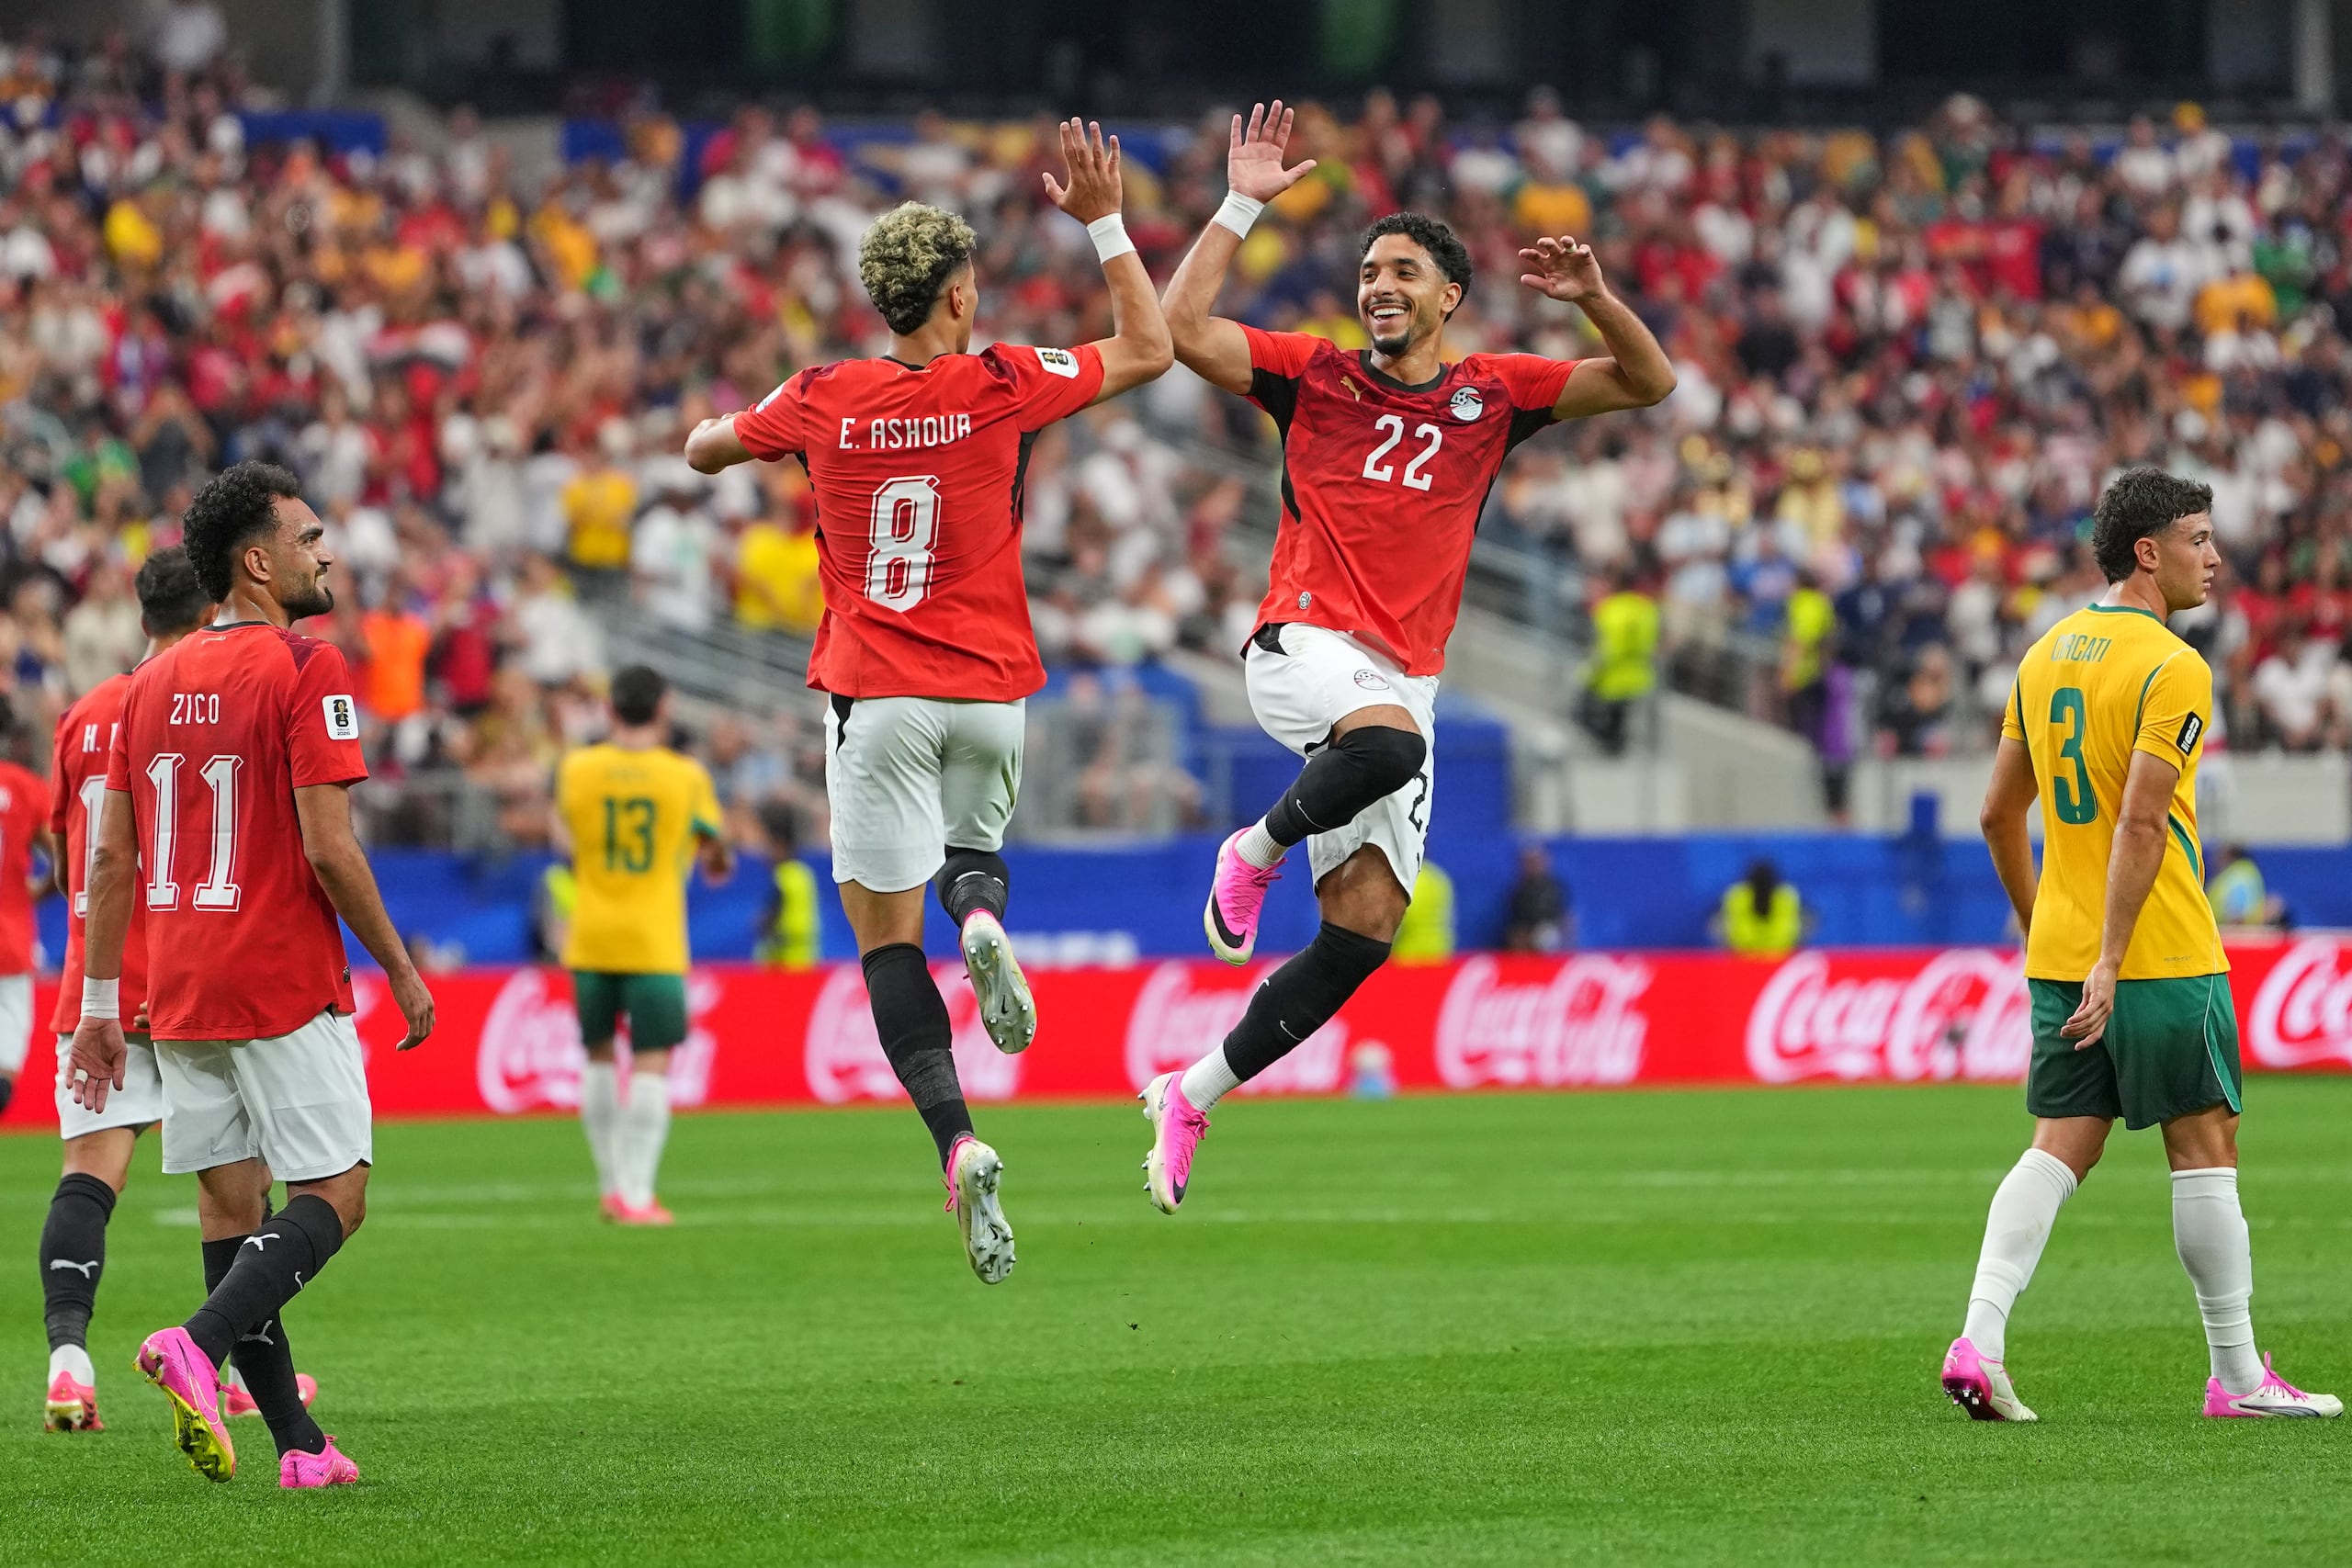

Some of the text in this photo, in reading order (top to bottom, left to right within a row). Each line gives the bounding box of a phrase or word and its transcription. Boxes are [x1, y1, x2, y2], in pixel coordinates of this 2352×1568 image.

[839, 413, 972, 449] E. ASHOUR
[1362, 413, 1442, 491] 22
[864, 474, 942, 613] 8
[82, 724, 101, 753] H.
[169, 693, 220, 725] ZICO
[2050, 687, 2098, 825] 3
[146, 753, 244, 912] 11
[603, 796, 659, 874] 13
